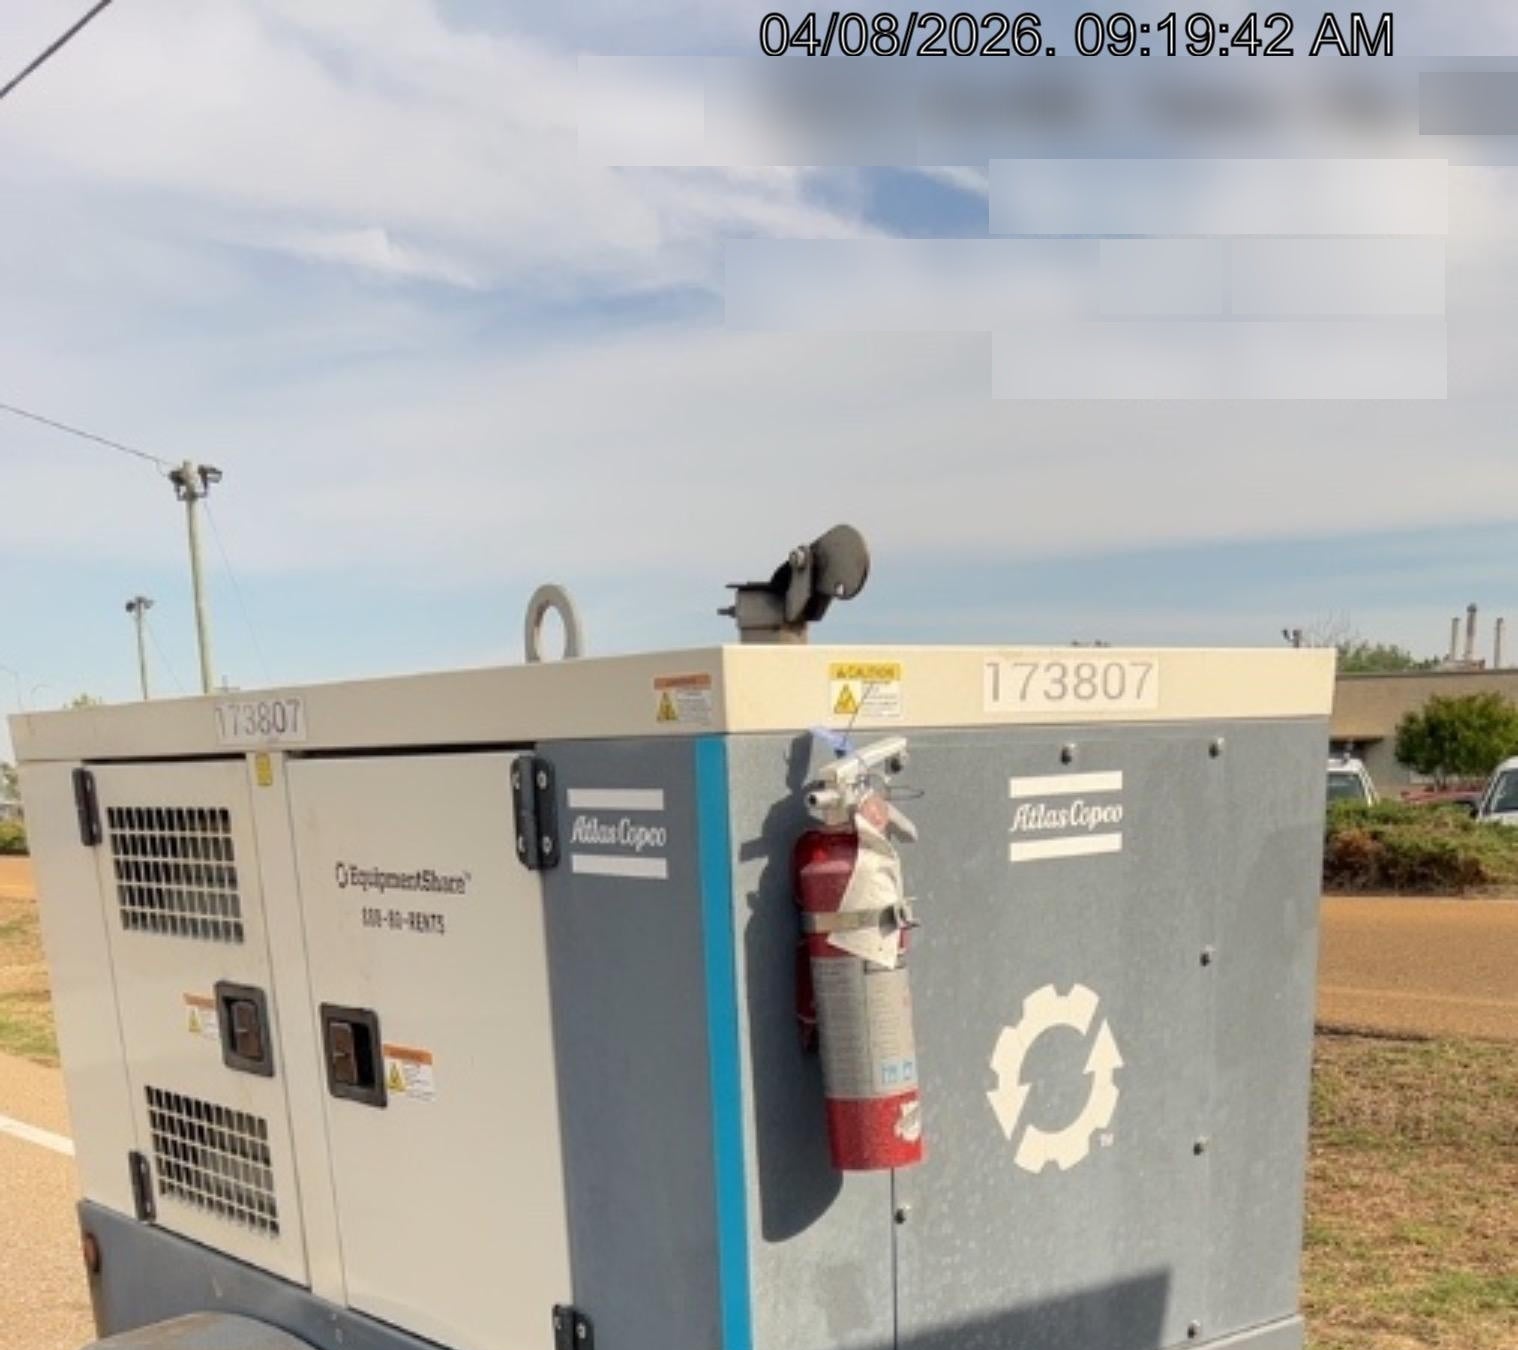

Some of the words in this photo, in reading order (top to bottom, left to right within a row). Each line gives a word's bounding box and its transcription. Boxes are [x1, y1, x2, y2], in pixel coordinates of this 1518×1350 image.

[984, 661, 1153, 702] 173807
[215, 698, 301, 737] 173807
[619, 816, 667, 853] Copco
[1010, 803, 1068, 832] Atlas
[1070, 800, 1123, 830] Copco
